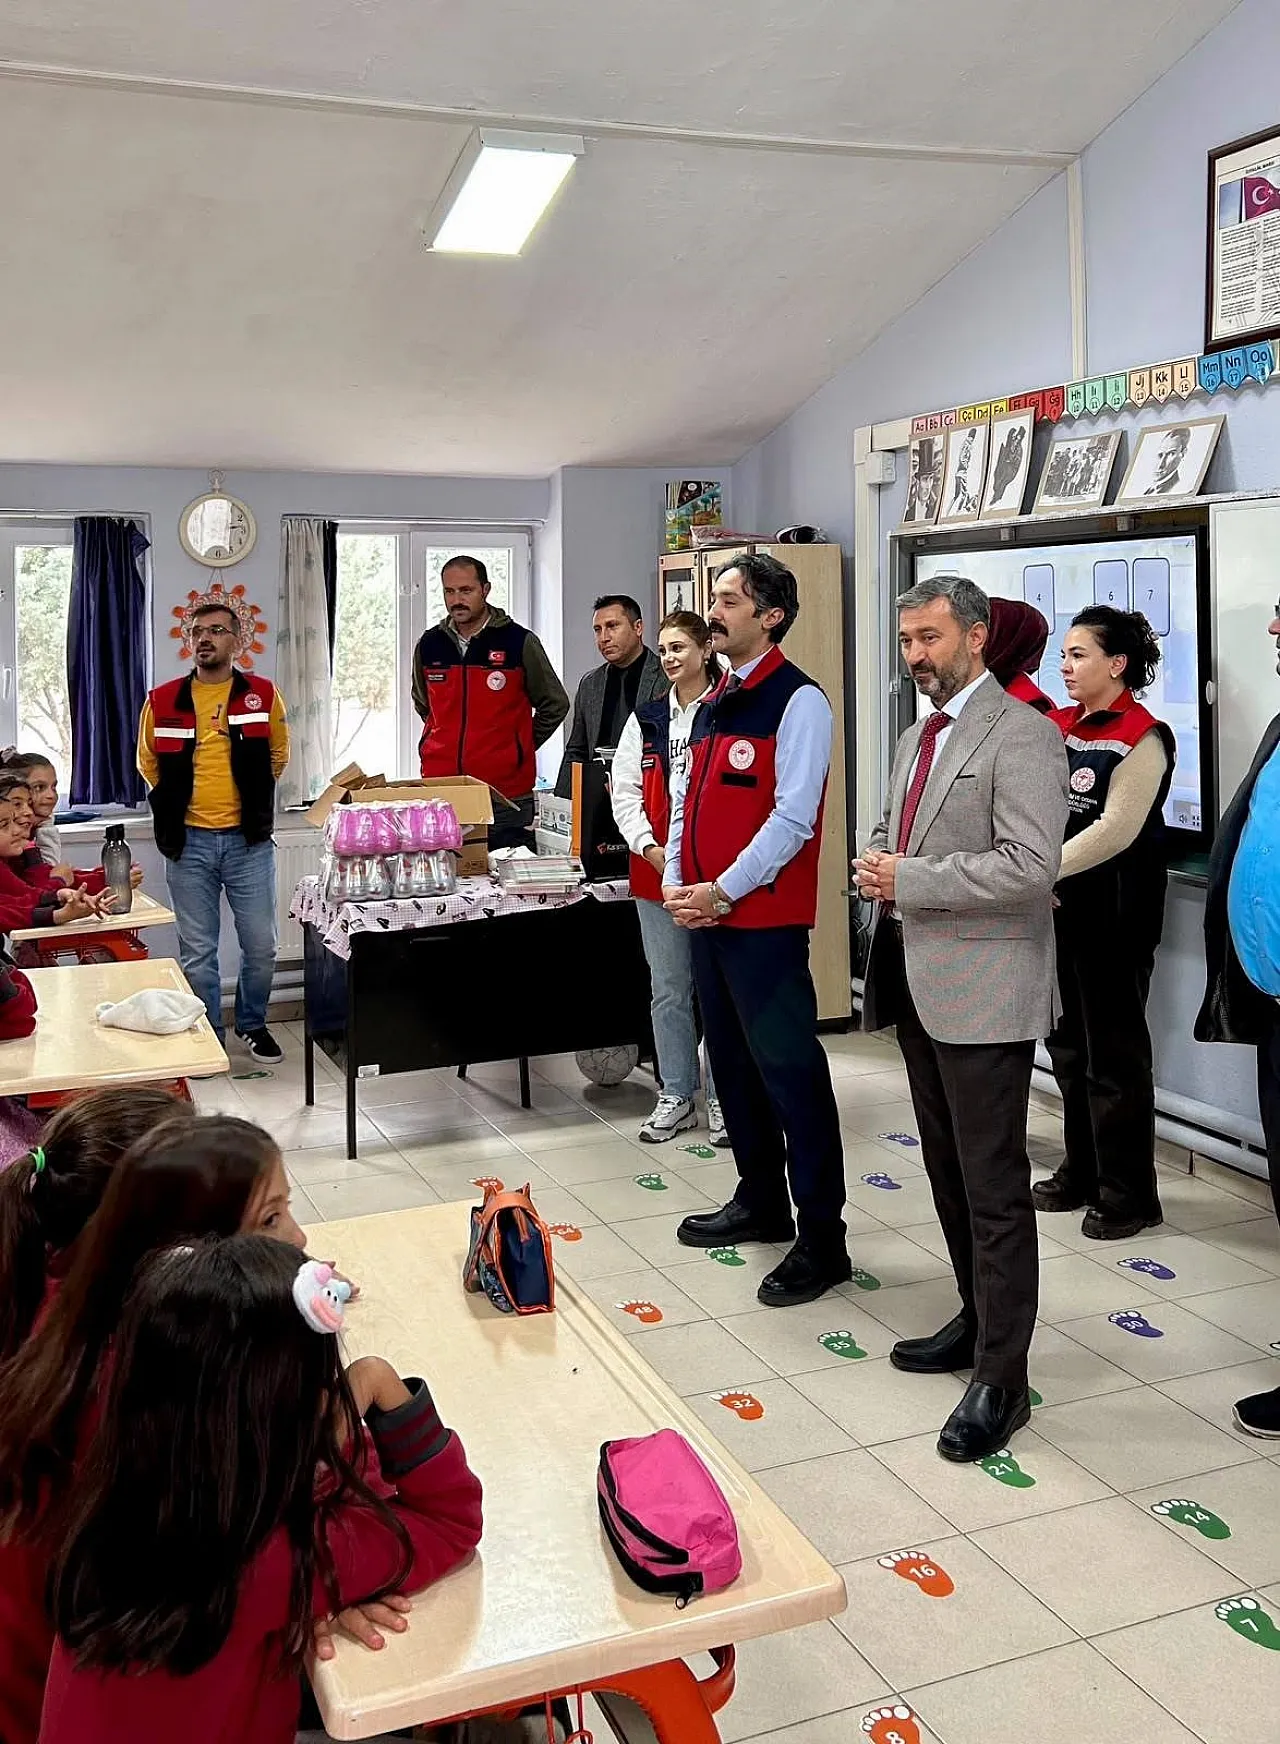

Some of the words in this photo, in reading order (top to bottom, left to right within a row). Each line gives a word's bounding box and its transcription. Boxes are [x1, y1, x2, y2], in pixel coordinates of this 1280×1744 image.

[916, 422, 924, 433] Aa
[930, 418, 938, 430] Bb
[1072, 391, 1081, 400] Hh
[1136, 374, 1144, 388] Jj
[1156, 371, 1168, 384] Kk
[1203, 362, 1219, 374] Mm
[1226, 356, 1241, 369] Nn
[1250, 350, 1268, 363] Oo
[1114, 397, 1121, 406] 12
[1158, 388, 1166, 397] 14
[1181, 384, 1188, 393] 15
[1208, 379, 1216, 388] 16
[1230, 372, 1238, 382] 17
[1036, 593, 1042, 602] 4
[1108, 591, 1114, 601] 6
[1148, 589, 1154, 600] 7
[634, 1306, 654, 1314] 48
[1122, 1320, 1144, 1330] 30
[828, 1340, 851, 1350] 35
[730, 1398, 756, 1408] 32
[988, 1462, 1014, 1476] 21
[1184, 1510, 1210, 1524] 14
[908, 1564, 937, 1579] 16
[1240, 1618, 1259, 1632] 7
[884, 1731, 906, 1744] 8
